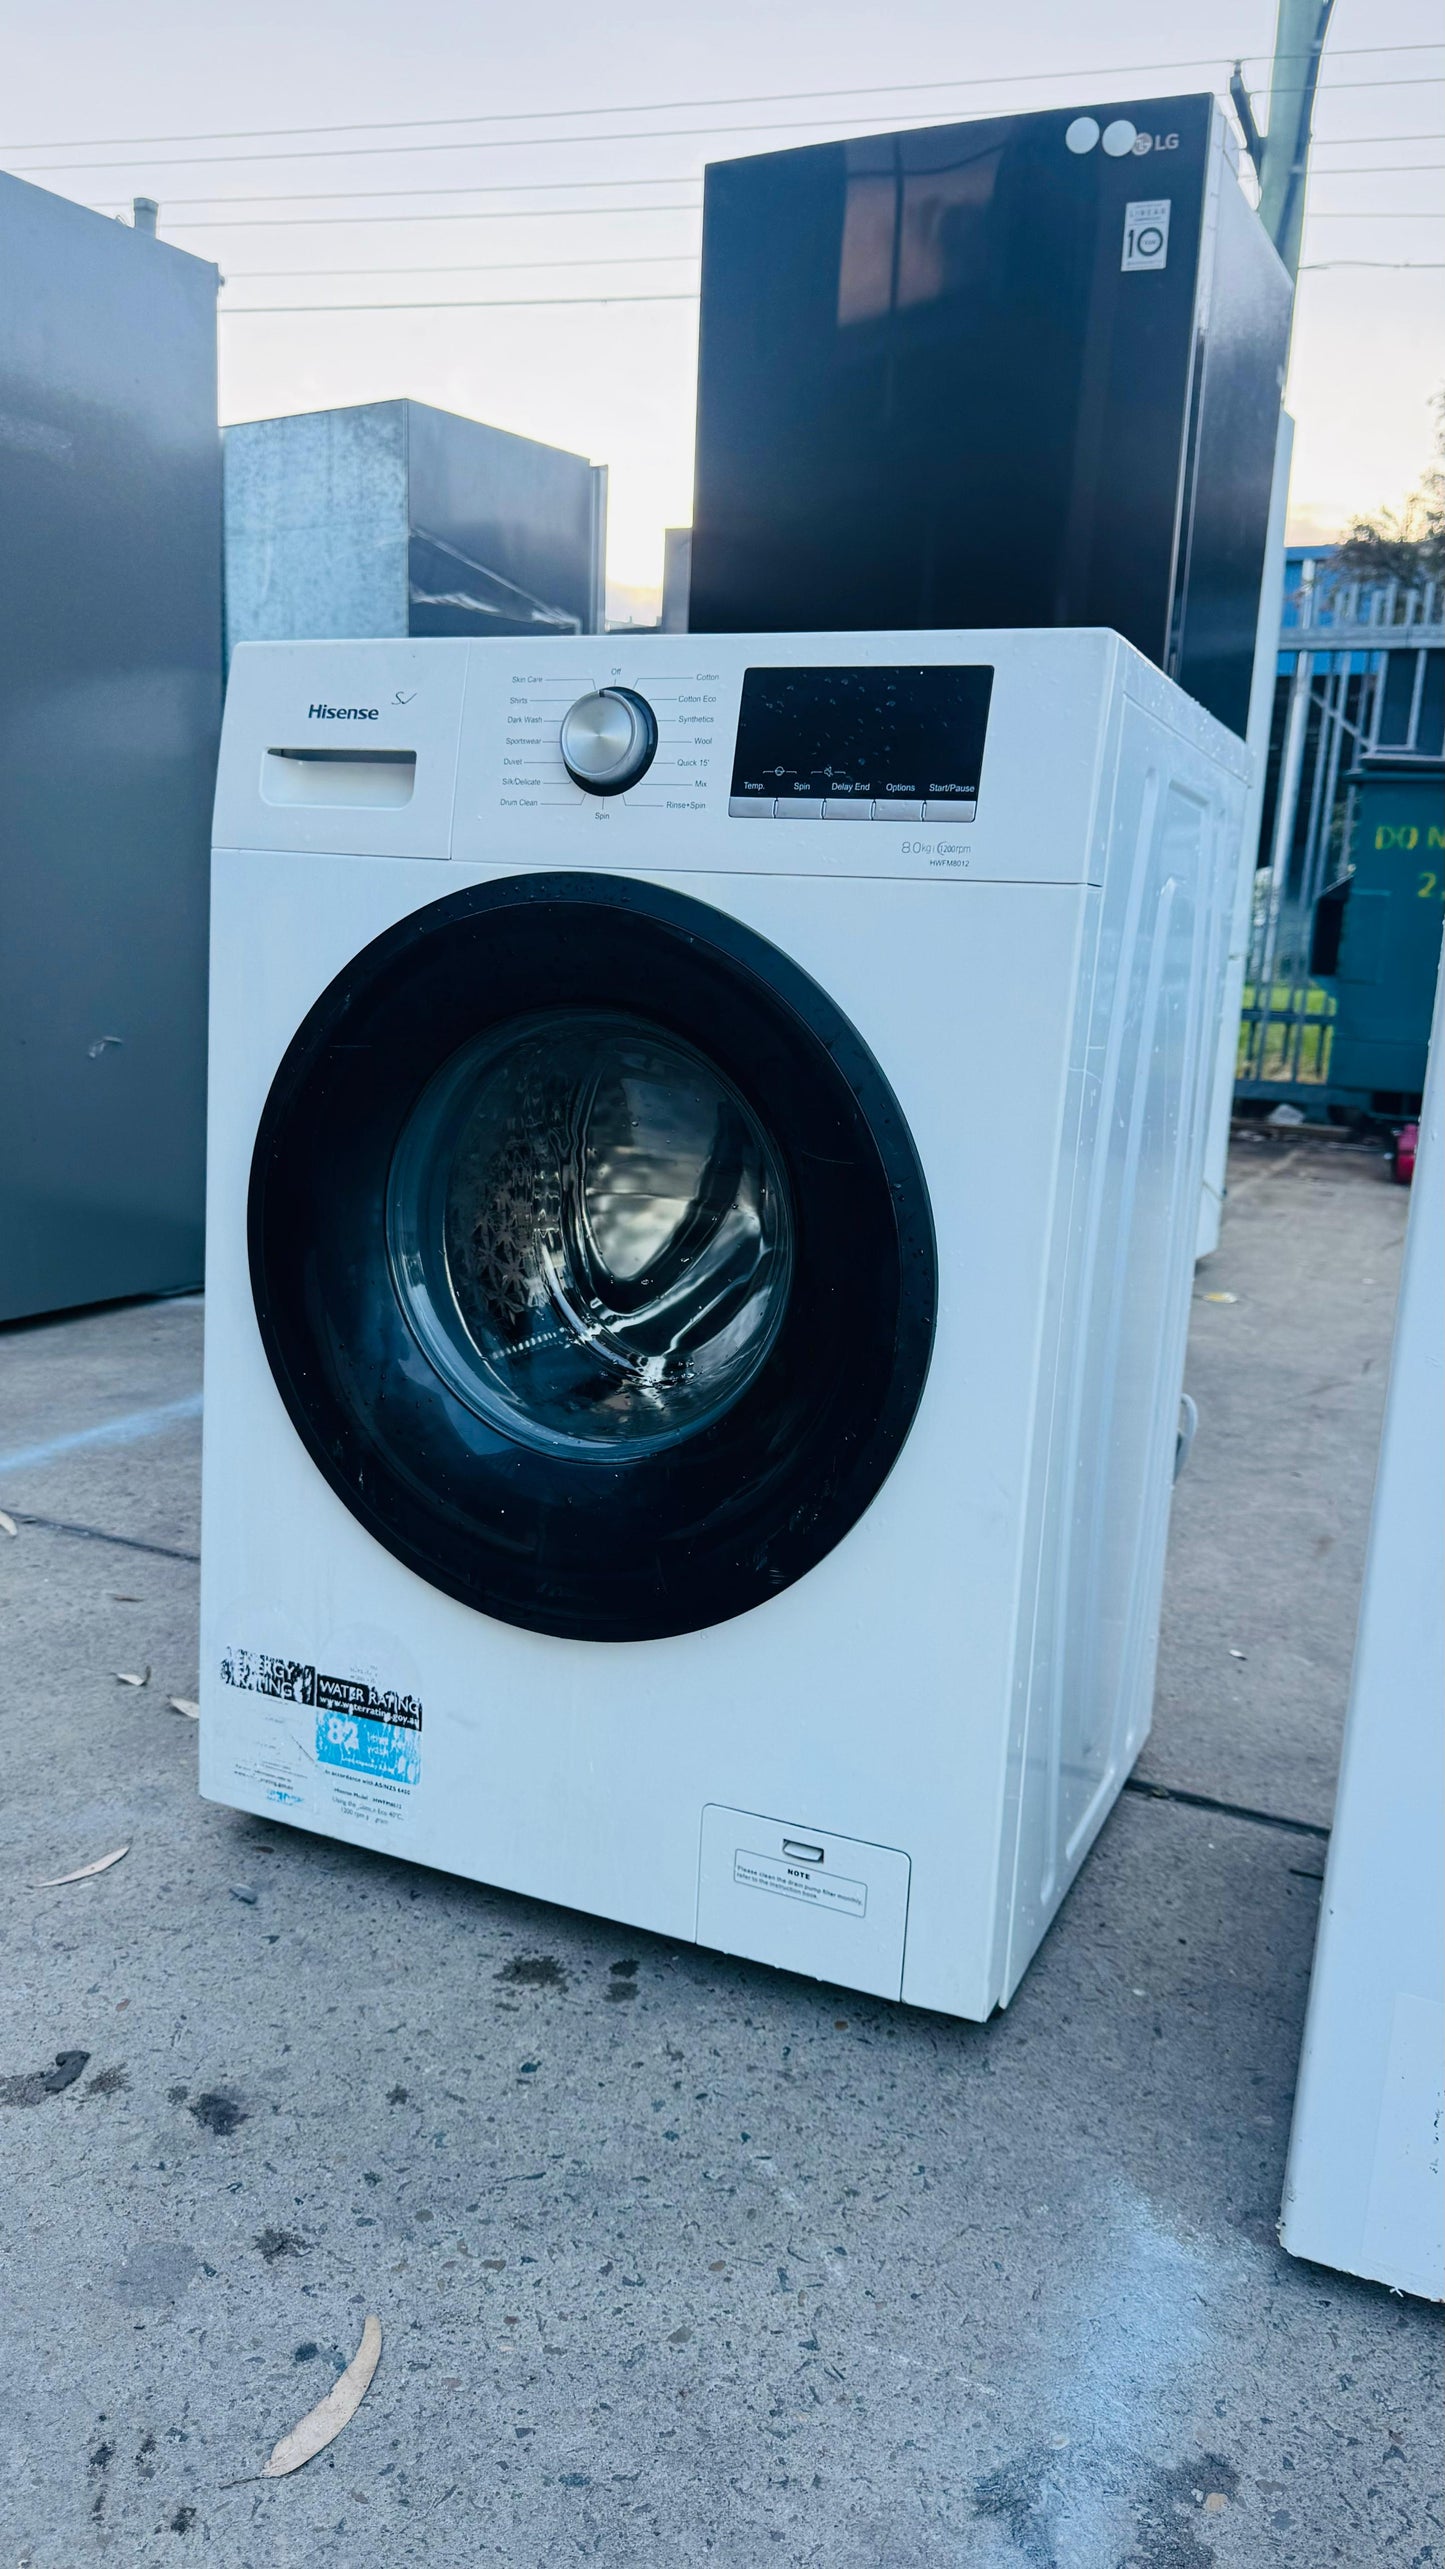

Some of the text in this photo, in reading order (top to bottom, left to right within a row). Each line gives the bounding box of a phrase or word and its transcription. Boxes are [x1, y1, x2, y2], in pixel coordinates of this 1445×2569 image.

[1154, 133, 1179, 150] LG
[611, 668, 621, 676] Off
[512, 675, 526, 683] Skin
[696, 673, 720, 681] Cotton
[678, 695, 717, 703] Cotton Eco
[308, 704, 379, 720] Hisense
[507, 715, 543, 724] Dark Wash
[678, 715, 715, 725] Synthetics
[505, 737, 542, 746] Sportswear
[694, 737, 713, 745] Wool
[503, 758, 523, 766] Duvet
[677, 759, 697, 767] Quick
[502, 777, 541, 786] Silk/Delicate
[694, 780, 707, 788] Mix
[743, 781, 766, 791] Temp.
[793, 783, 811, 792] Spin
[831, 782, 870, 792] Delay End
[886, 783, 916, 793] Options
[928, 783, 976, 793] Start/Pause
[500, 798, 539, 807] Drum Clean
[594, 812, 610, 820] Spin
[1374, 825, 1419, 850] DO
[320, 1679, 419, 1715] WATER RATING
[737, 1864, 758, 1876] Please
[787, 1868, 811, 1881] NOTE
